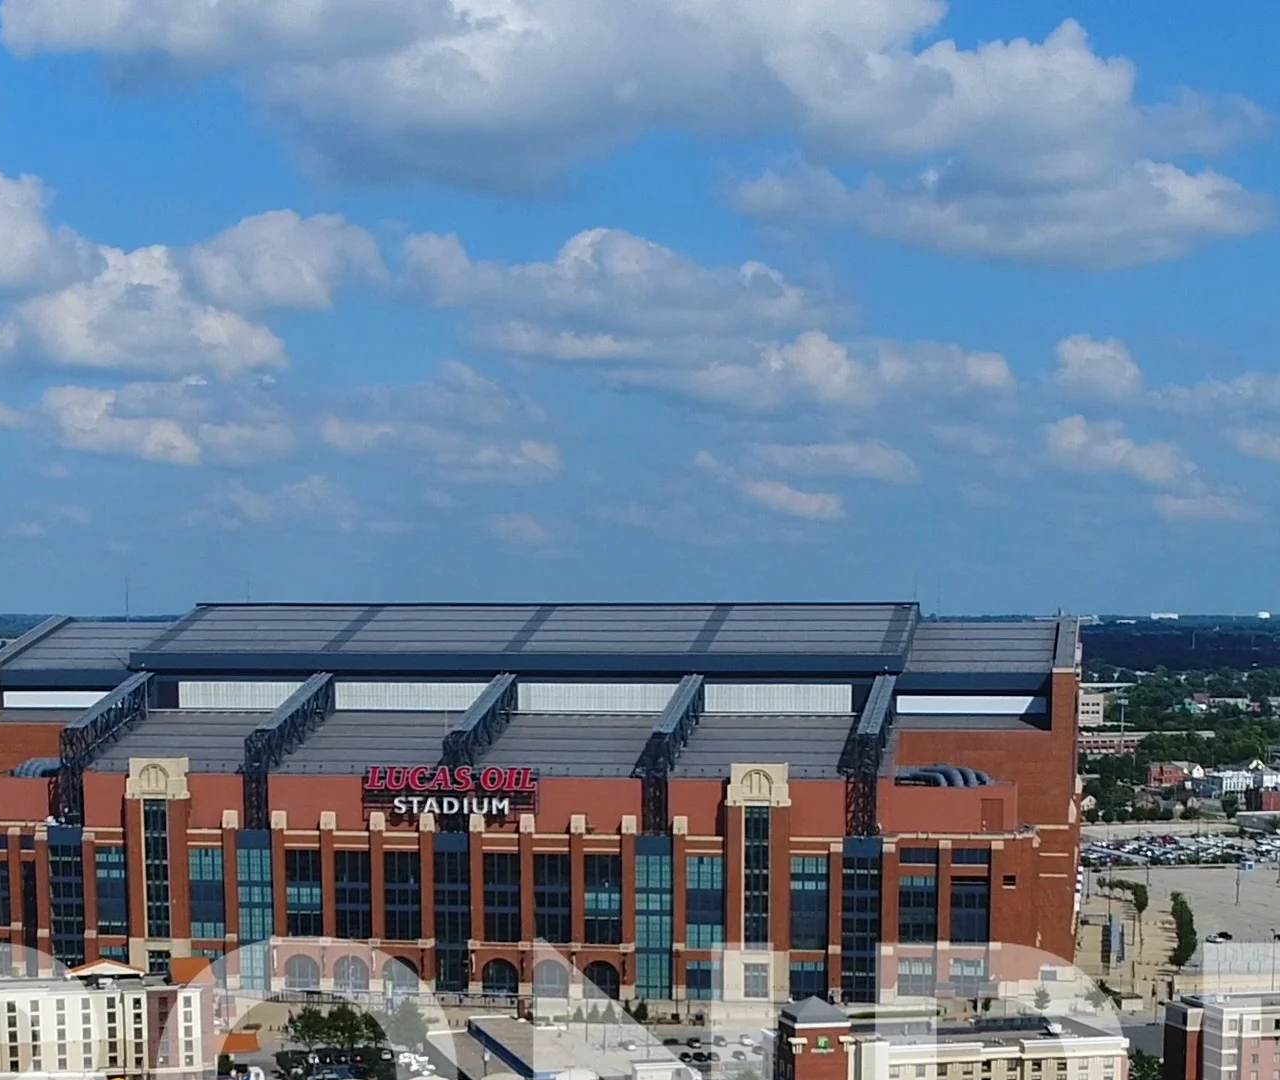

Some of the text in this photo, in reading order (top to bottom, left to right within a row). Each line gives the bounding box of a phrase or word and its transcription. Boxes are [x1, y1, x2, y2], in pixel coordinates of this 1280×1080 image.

[366, 765, 536, 791] LUCAS OIL
[393, 796, 510, 815] STADIUM
